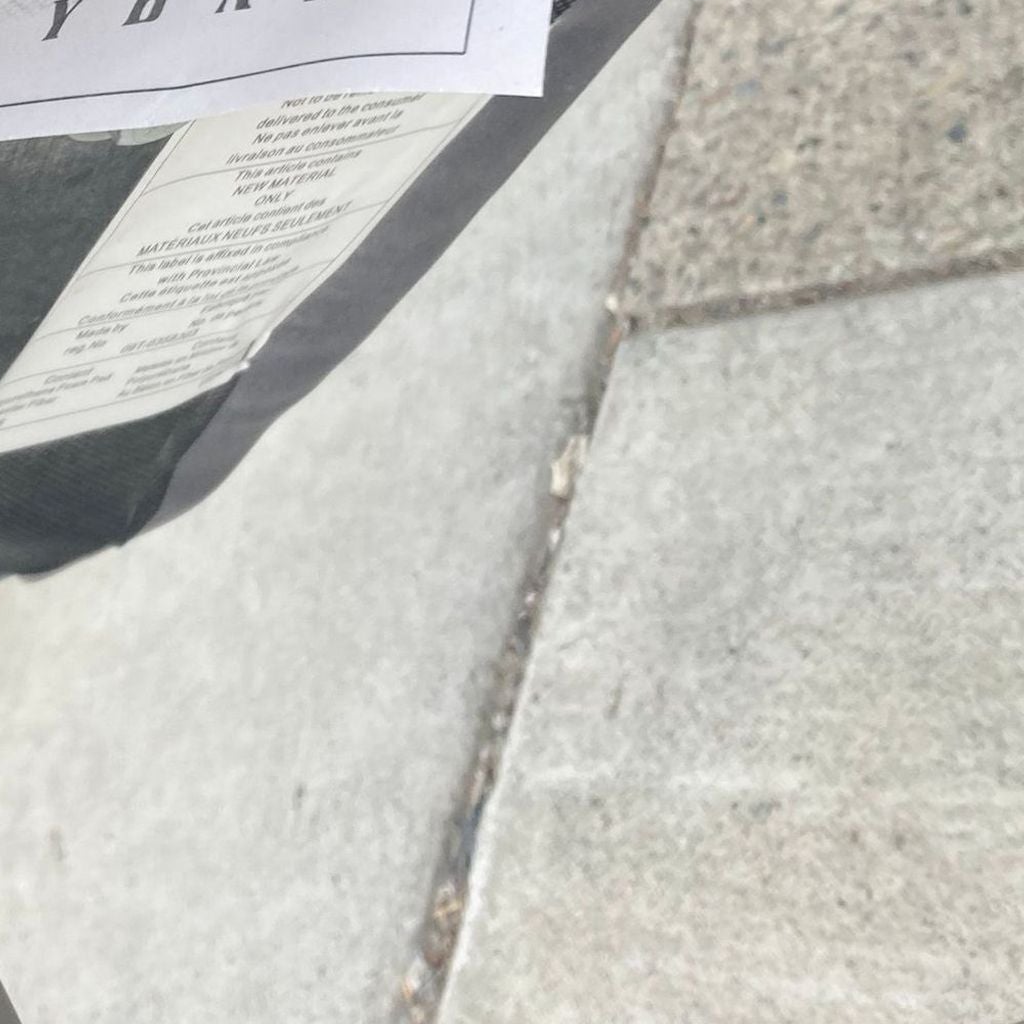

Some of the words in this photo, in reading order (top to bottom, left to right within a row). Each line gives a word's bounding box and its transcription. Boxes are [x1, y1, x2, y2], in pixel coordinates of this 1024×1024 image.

[254, 109, 324, 129] delivered
[299, 120, 353, 136] enlever
[351, 112, 391, 127] avant
[225, 146, 287, 164] livraison
[233, 168, 266, 181] This
[263, 160, 309, 175] article
[307, 150, 363, 167] contains
[267, 167, 340, 188] MATERIAL
[251, 191, 294, 206] ONLY
[210, 214, 253, 228] article
[220, 223, 274, 239] NEUFS
[269, 200, 355, 231] SEULEMENT
[126, 262, 158, 274] This
[156, 256, 192, 268] label
[205, 245, 252, 259] affixed
[155, 272, 187, 285] with
